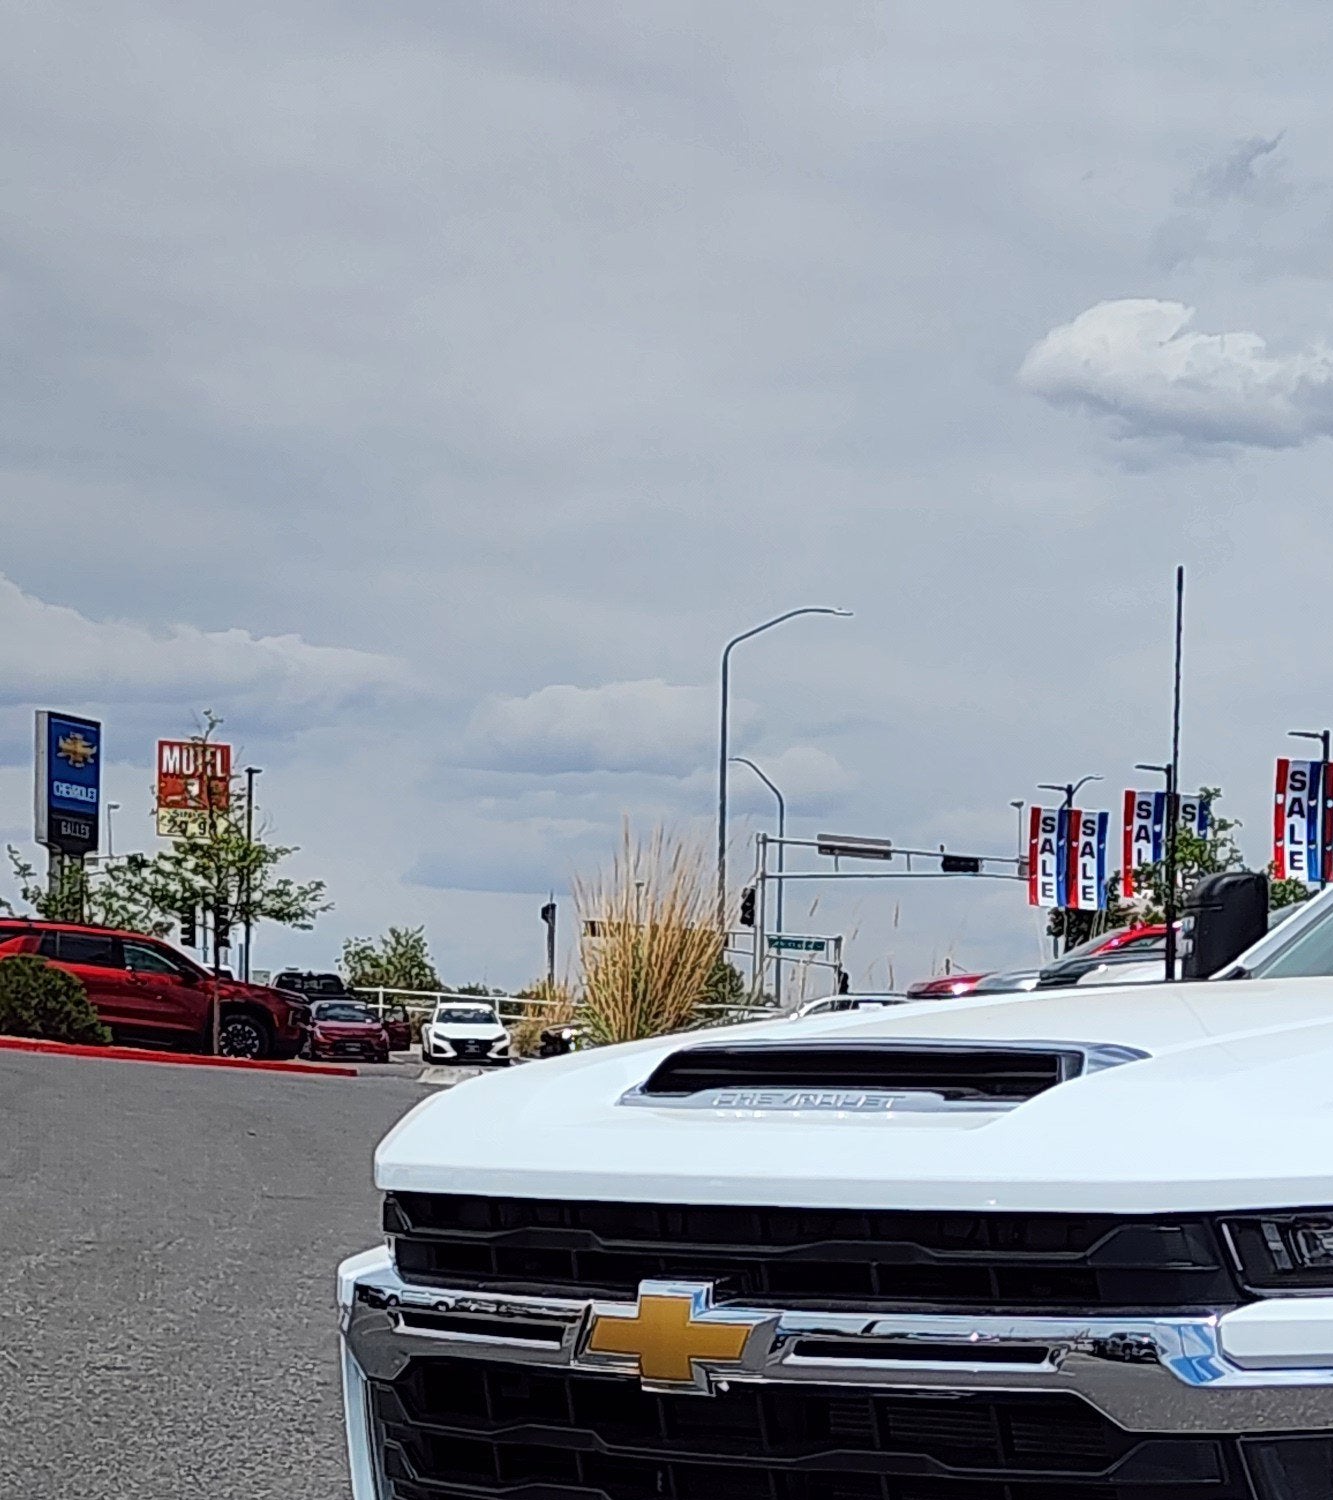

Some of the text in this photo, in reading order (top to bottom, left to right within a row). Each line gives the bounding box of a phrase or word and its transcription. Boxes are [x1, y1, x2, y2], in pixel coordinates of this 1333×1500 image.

[1039, 816, 1056, 899] SALE
[1079, 819, 1096, 902] SALE
[1134, 801, 1151, 870] SAL
[1286, 771, 1307, 871] SALE
